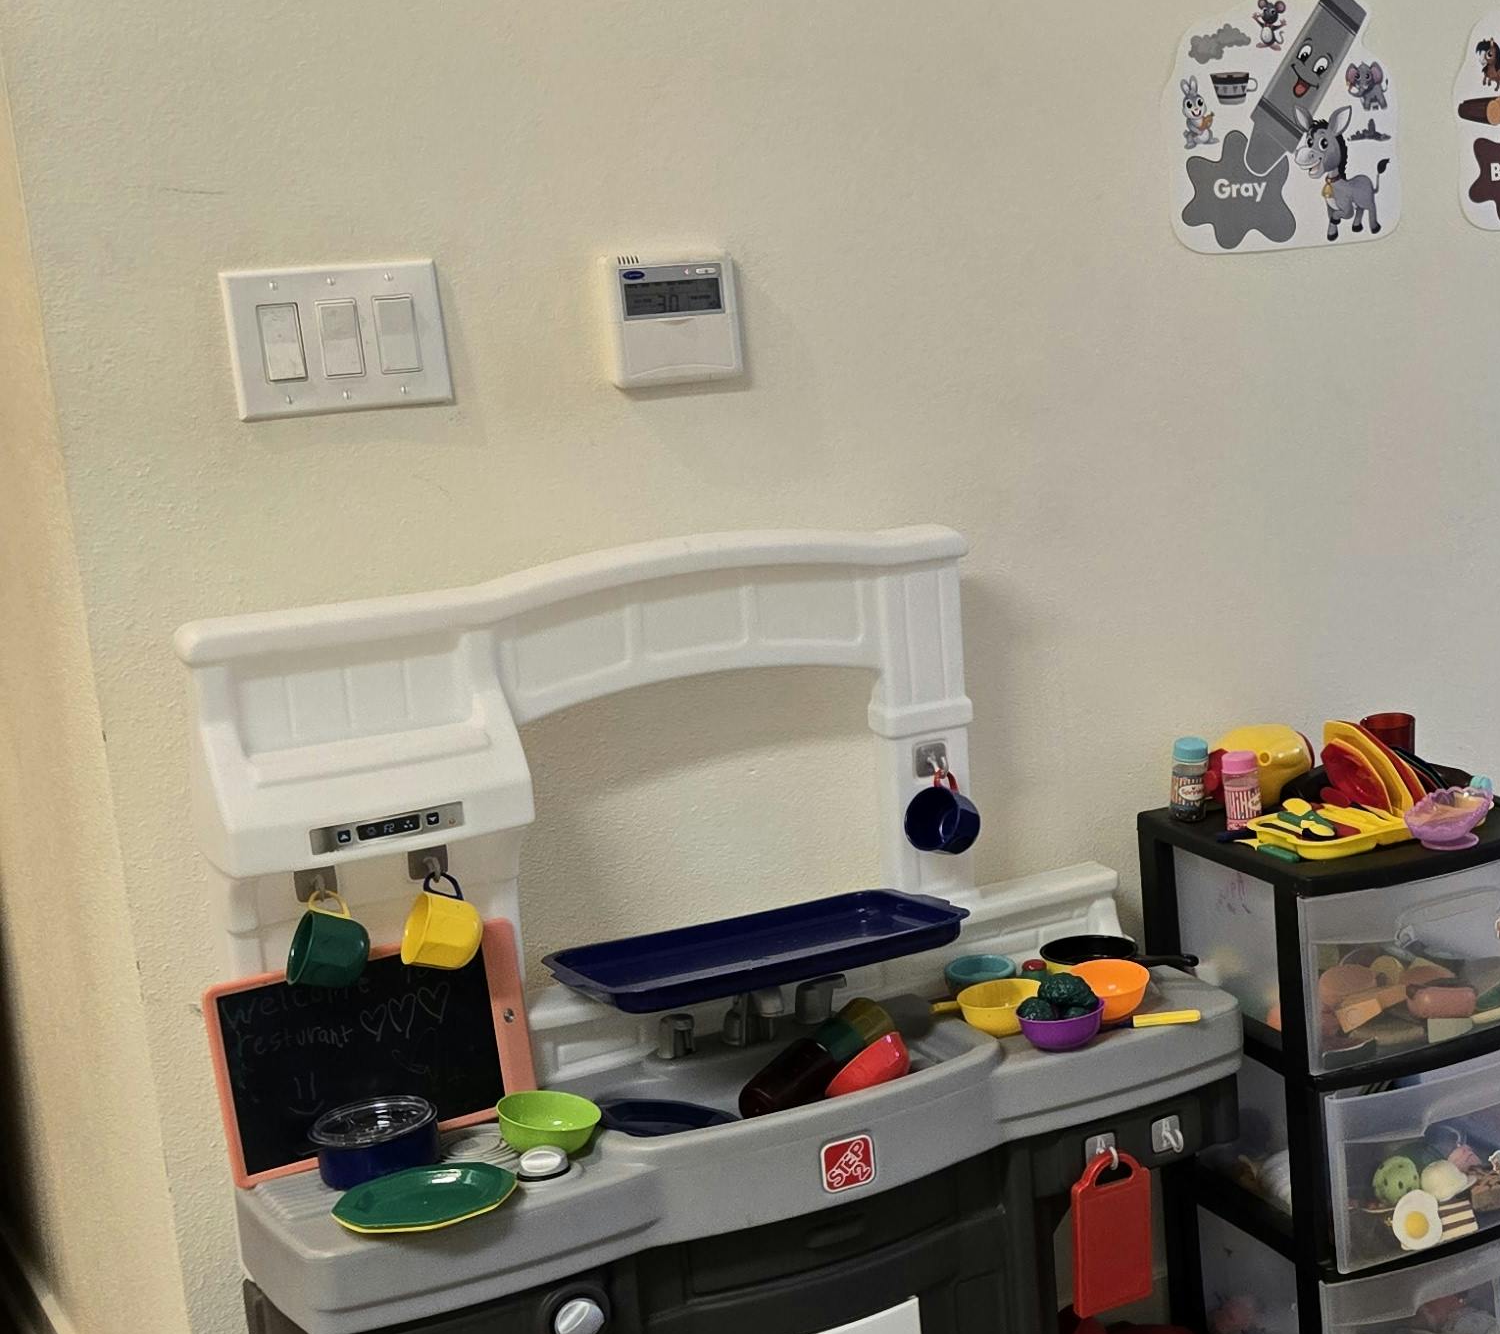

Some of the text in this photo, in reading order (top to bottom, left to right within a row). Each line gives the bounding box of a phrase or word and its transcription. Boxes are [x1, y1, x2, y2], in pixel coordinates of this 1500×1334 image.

[1213, 178, 1268, 203] Gray
[827, 1139, 865, 1187] STEP
[853, 1162, 871, 1181] 2
